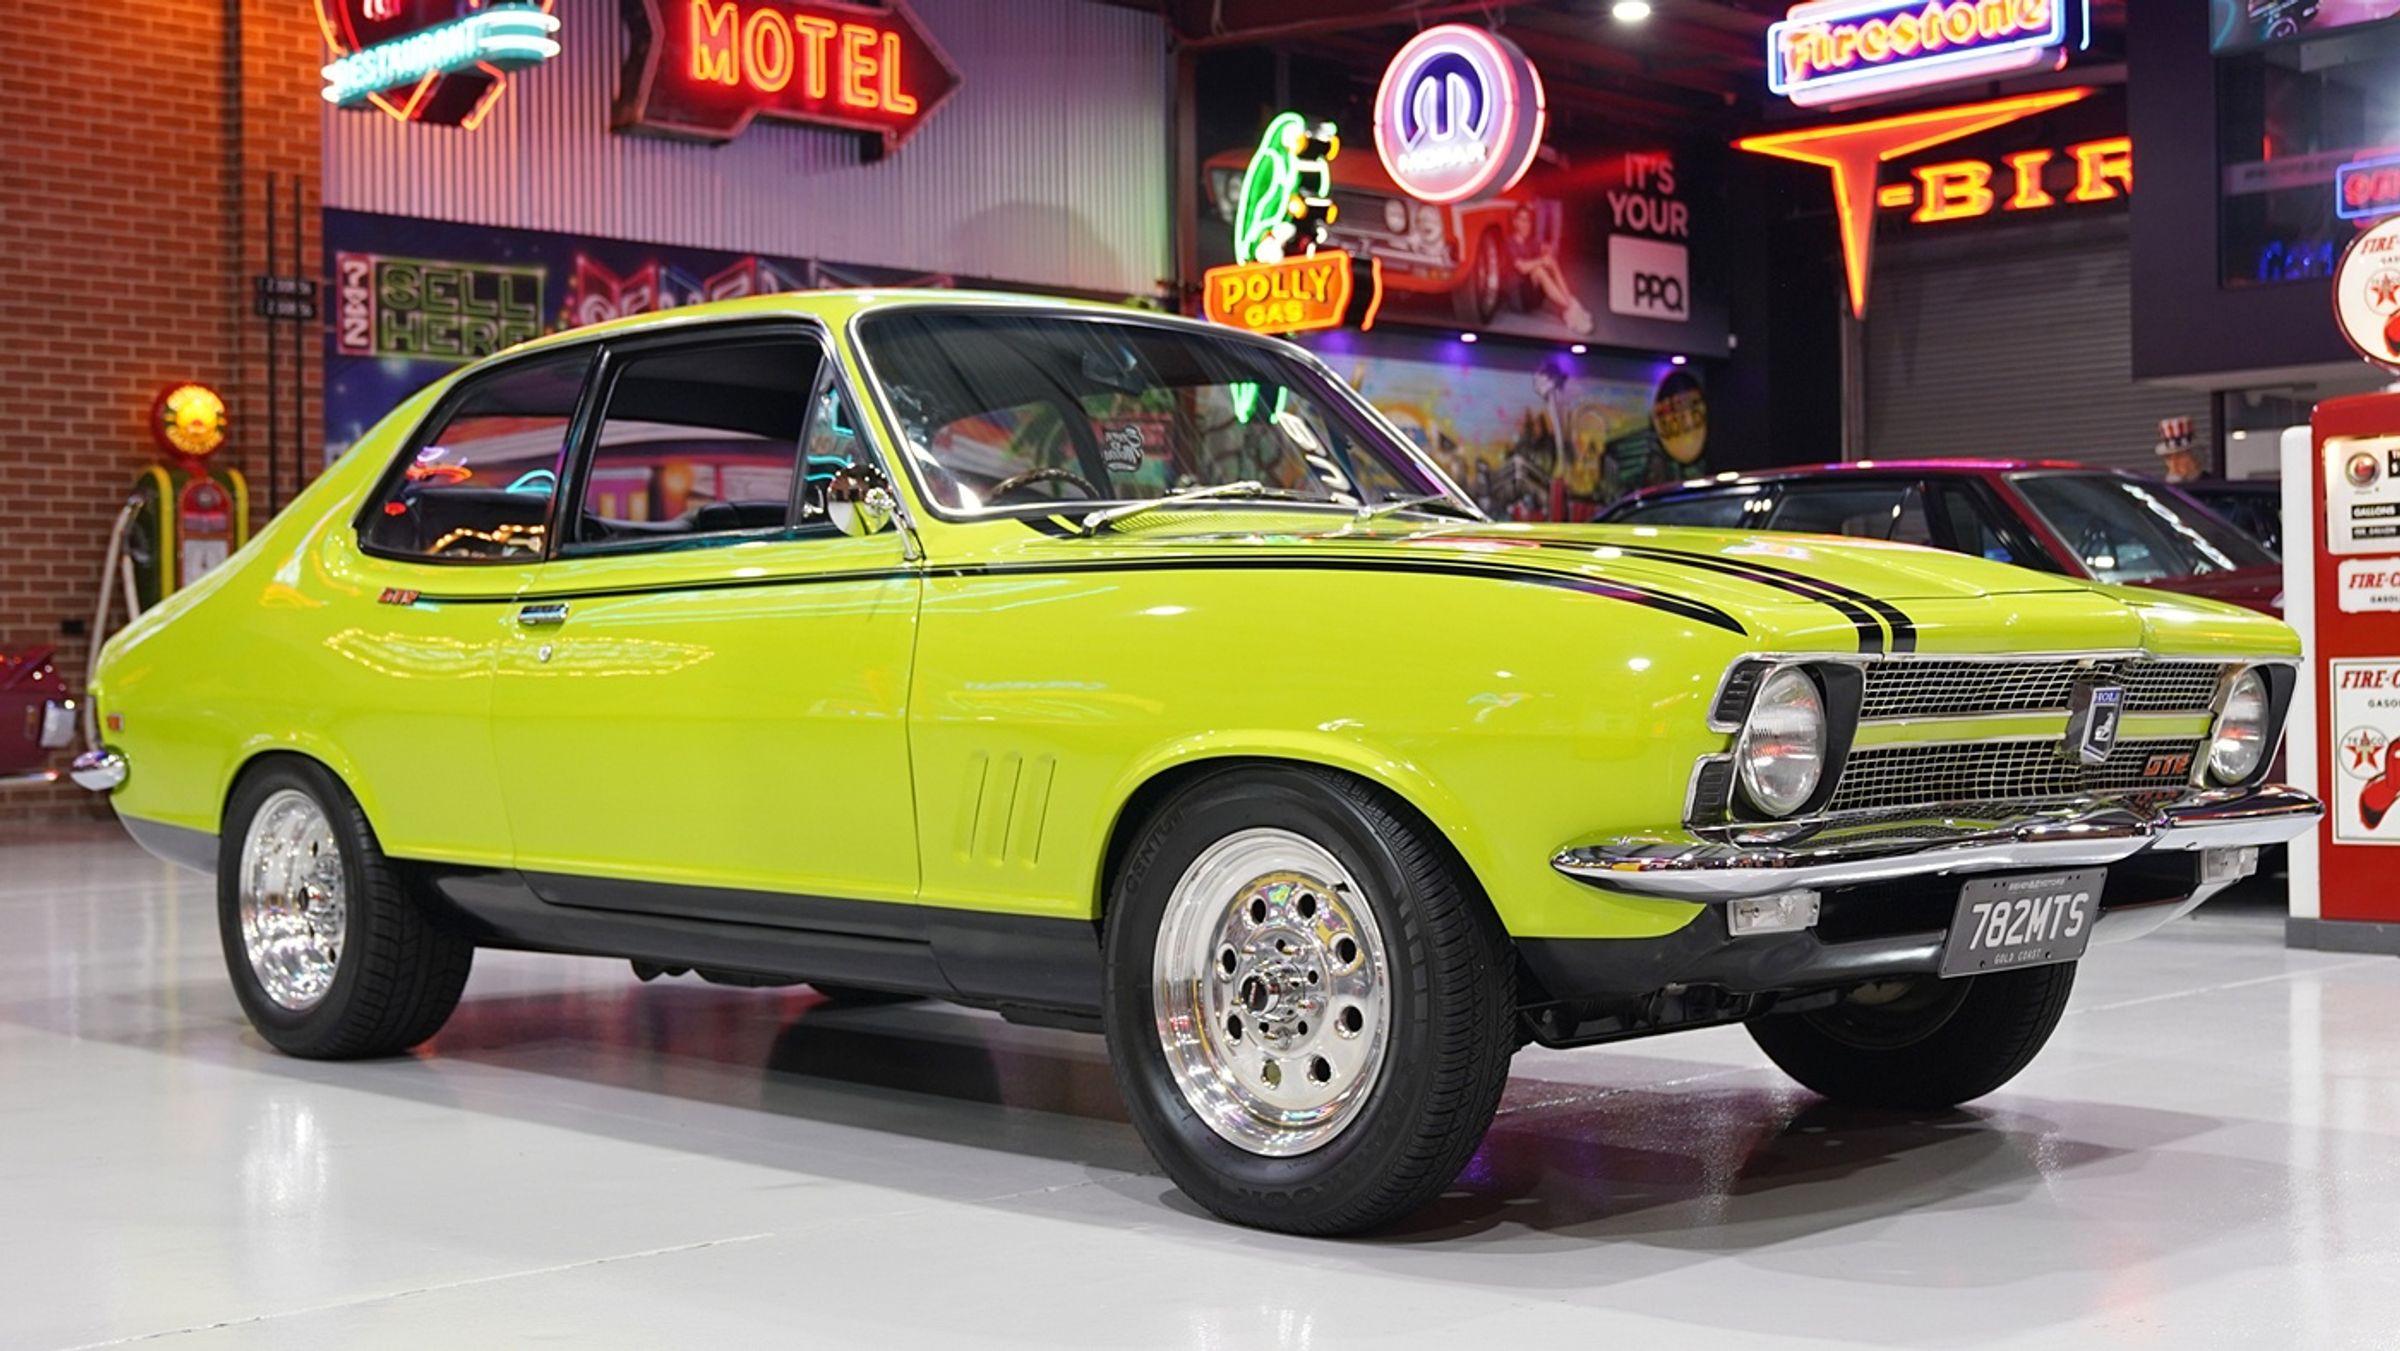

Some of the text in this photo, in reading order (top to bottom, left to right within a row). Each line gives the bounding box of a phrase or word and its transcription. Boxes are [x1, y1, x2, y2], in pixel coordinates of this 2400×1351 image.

[331, 18, 479, 97] RESTAURANT
[690, 0, 918, 115] MOTEL
[1781, 0, 2051, 82] Firestone
[1624, 153, 1676, 195] IT'S
[1607, 190, 1689, 238] YOUR
[380, 264, 537, 319] SELL
[1219, 265, 1332, 313] POLLY
[1633, 271, 1684, 313] PPQ
[1244, 301, 1304, 327] GAS
[2143, 753, 2190, 777] GTR
[1969, 892, 2090, 951] 782MTS
[1993, 952, 2014, 965] GOLD
